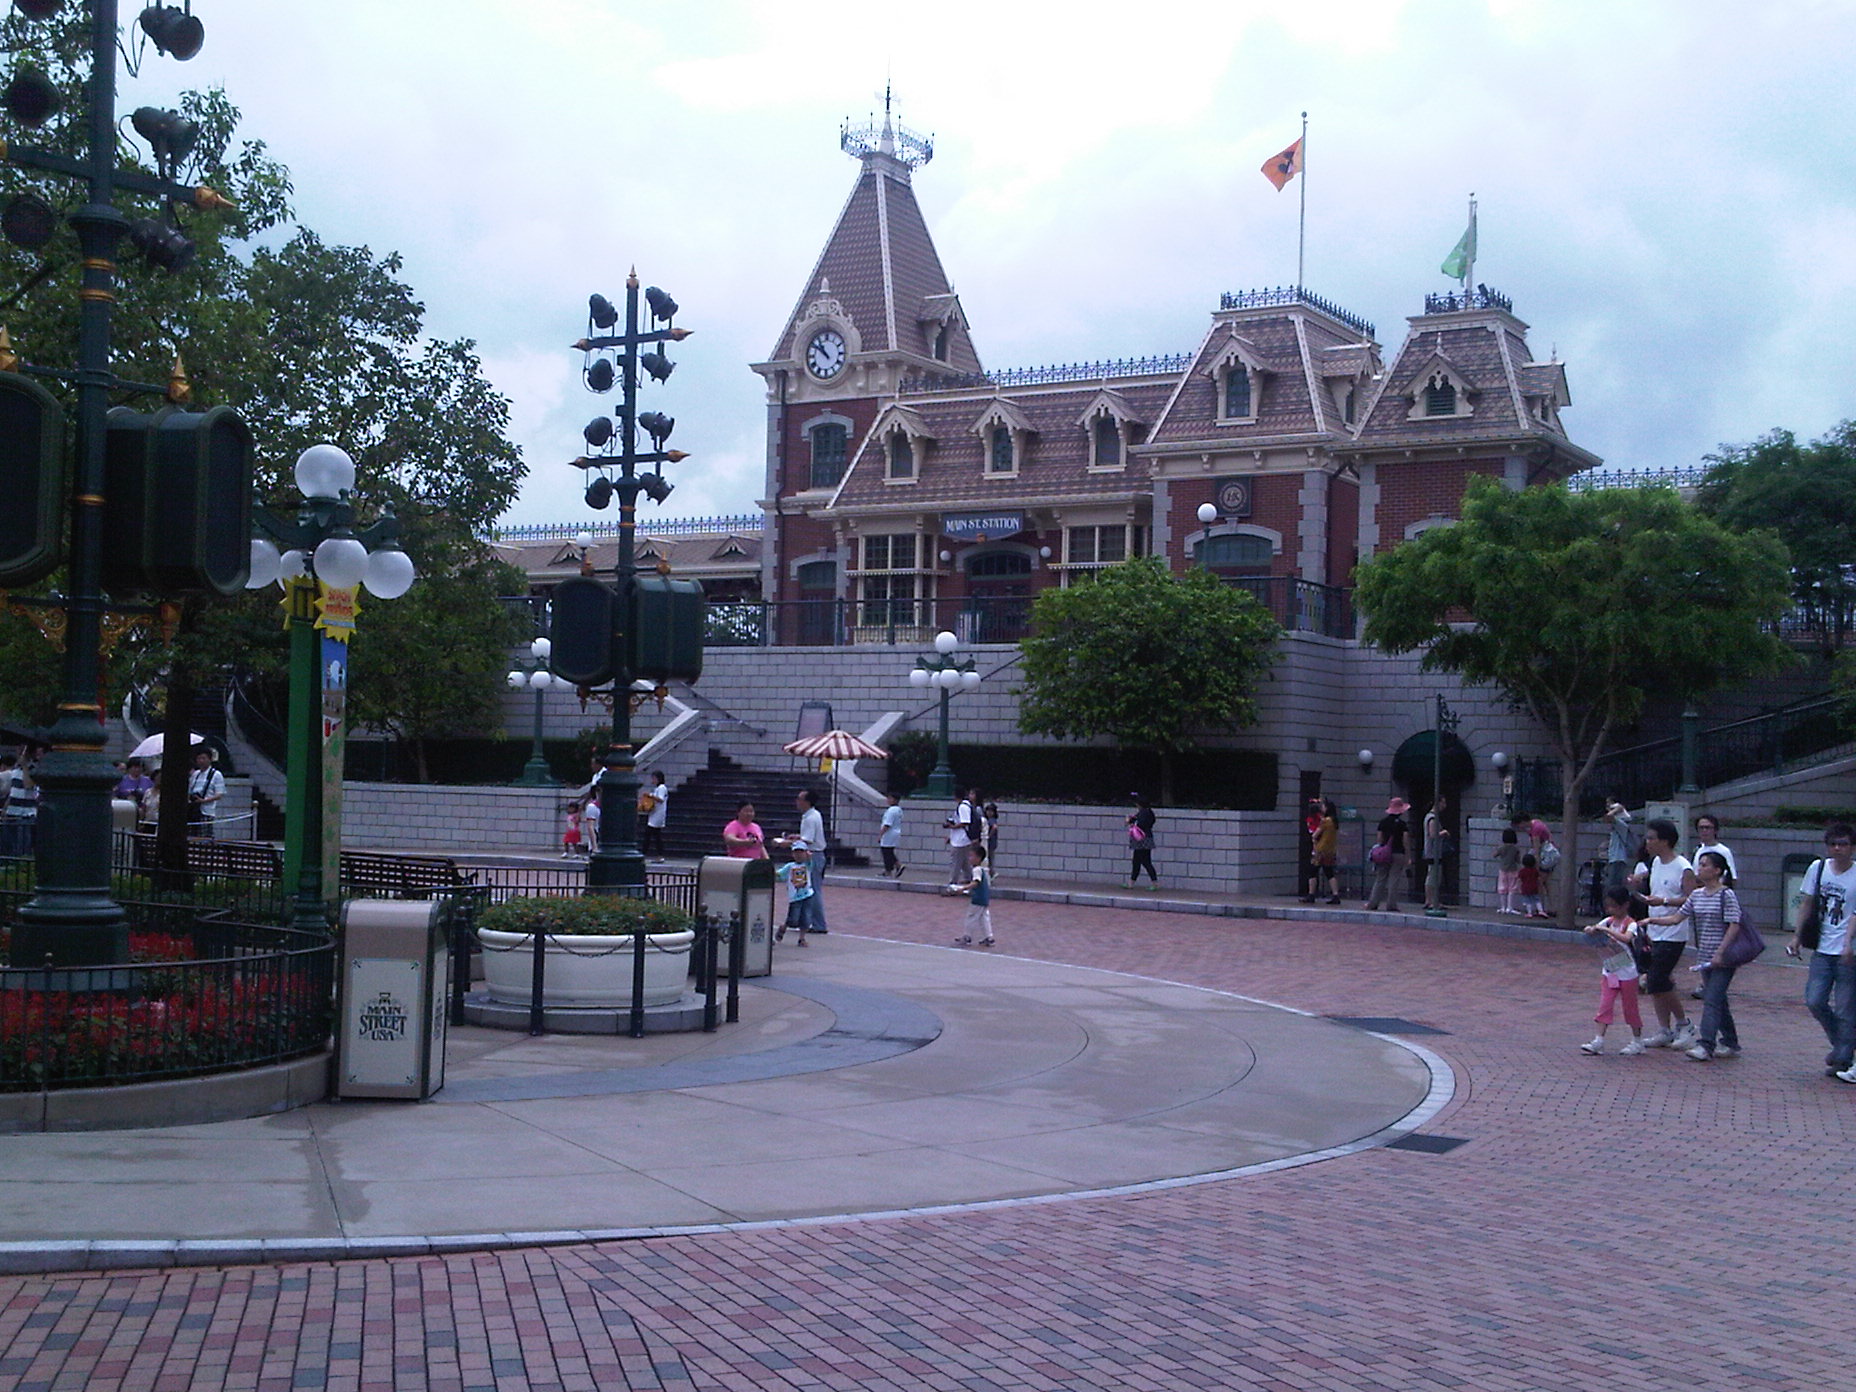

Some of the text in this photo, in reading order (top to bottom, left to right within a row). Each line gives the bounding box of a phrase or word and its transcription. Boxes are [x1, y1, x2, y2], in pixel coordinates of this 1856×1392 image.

[946, 519, 967, 532] MAIN
[982, 517, 1019, 530] STATION
[367, 1006, 401, 1015] MAIN
[359, 1014, 408, 1036] STREET
[371, 1030, 394, 1041] USA
